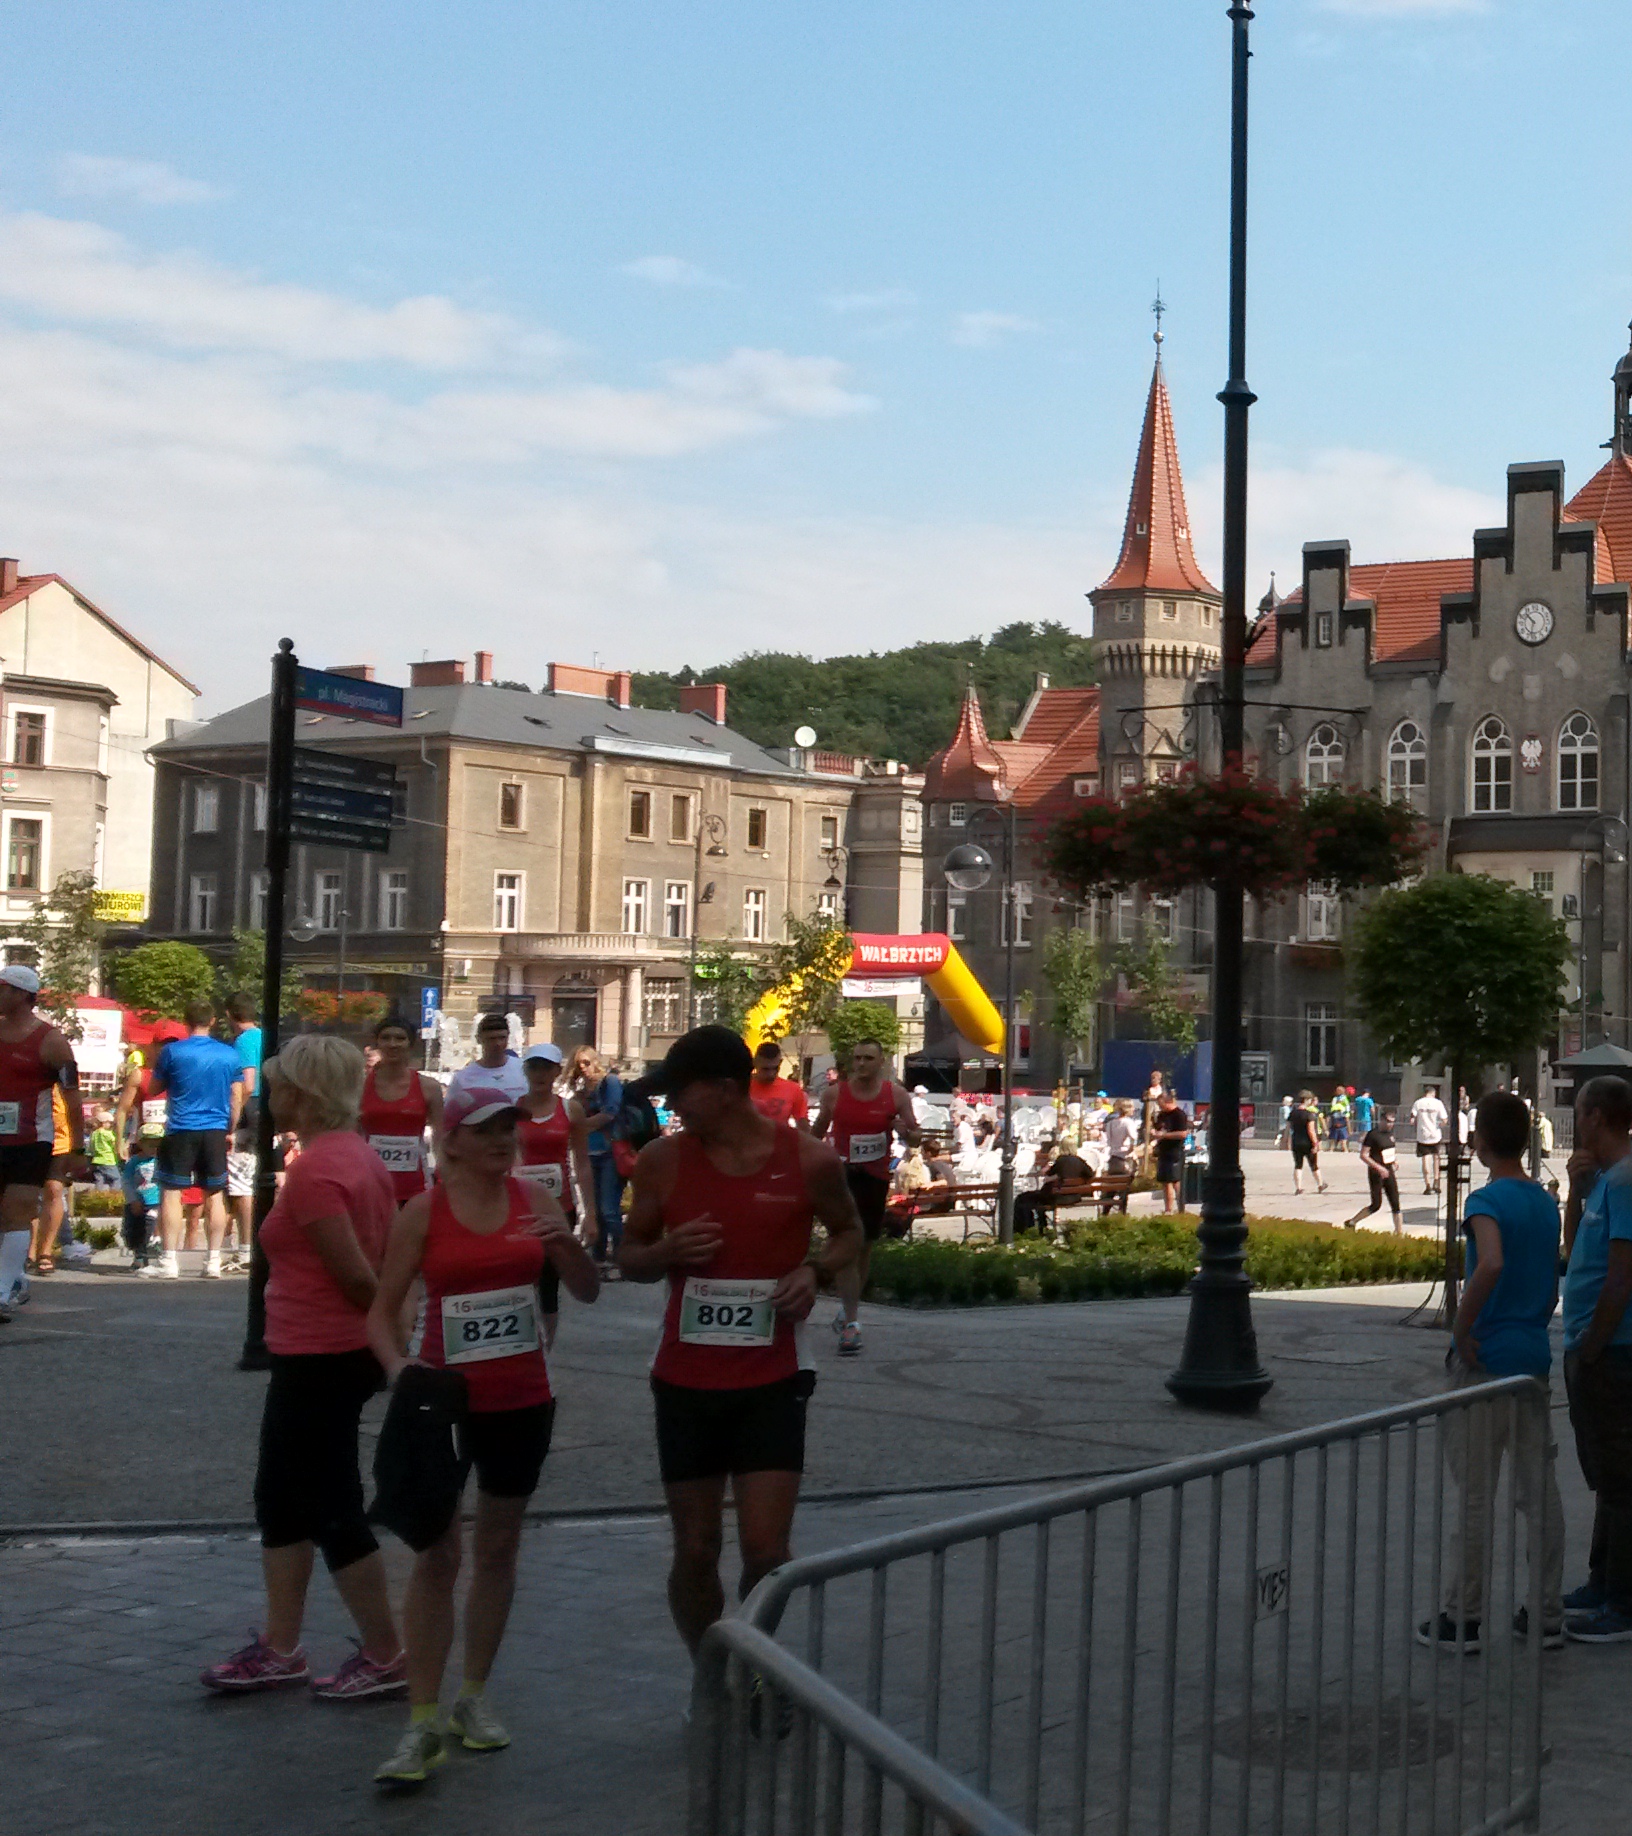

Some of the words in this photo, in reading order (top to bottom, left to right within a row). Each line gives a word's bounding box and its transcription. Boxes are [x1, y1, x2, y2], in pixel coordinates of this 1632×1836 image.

[860, 945, 942, 963] WAŁBRZYCH
[424, 1007, 434, 1022] P
[697, 1305, 753, 1327] 802
[463, 1315, 520, 1342] 822
